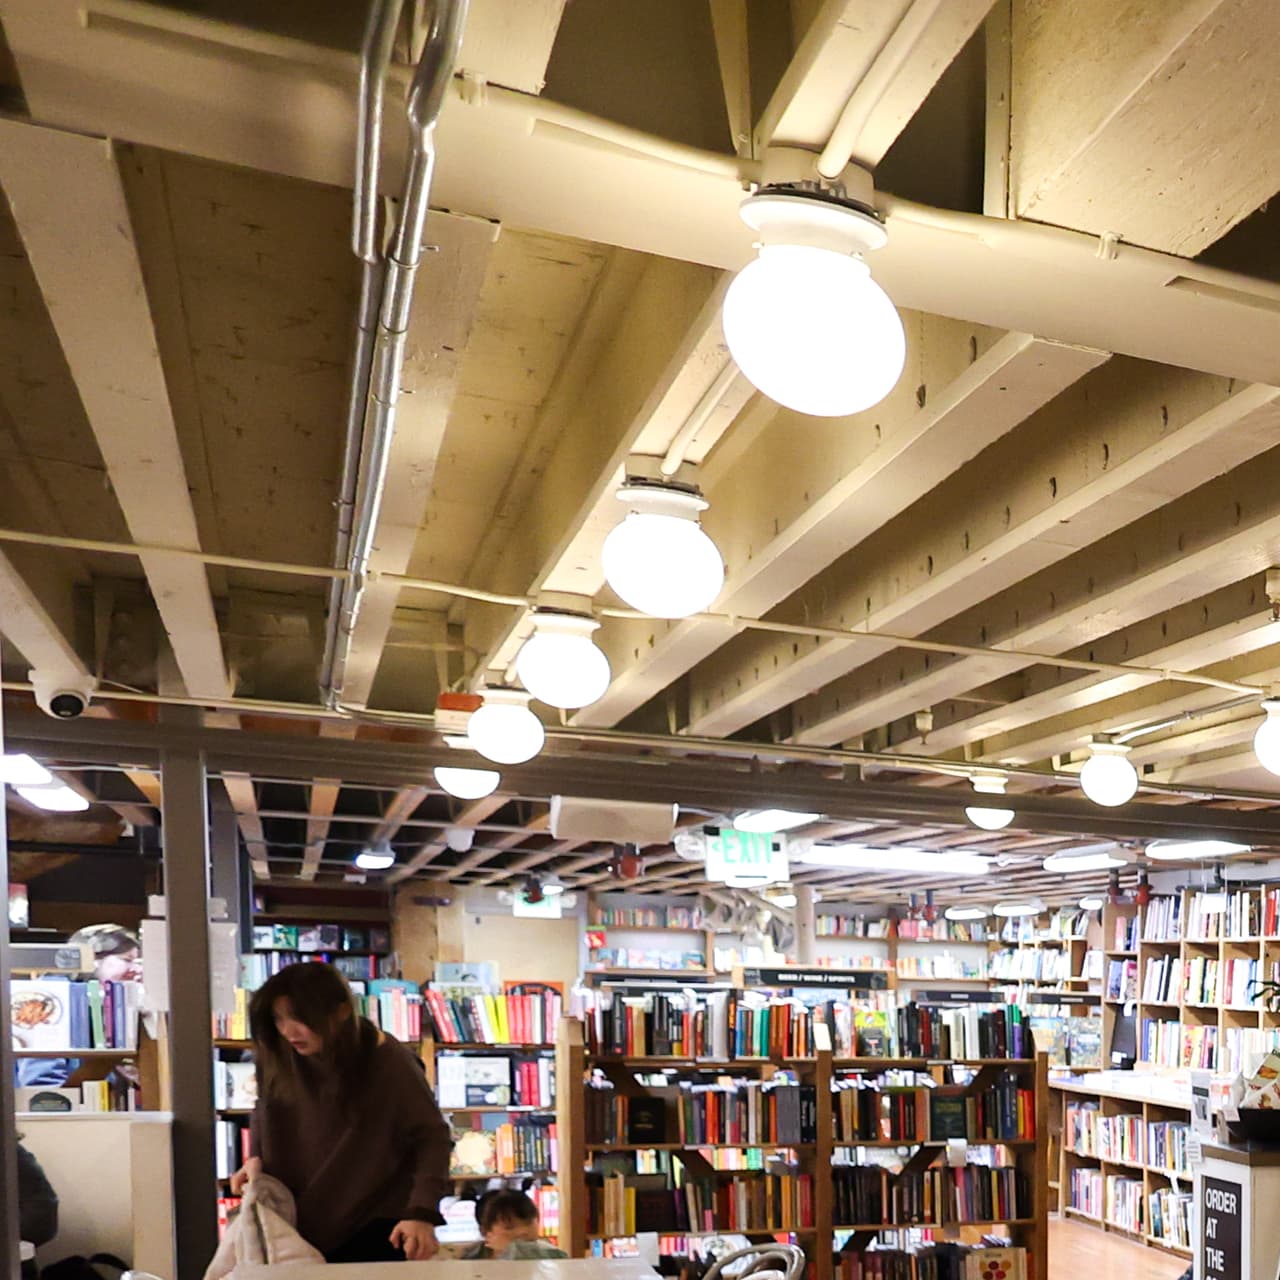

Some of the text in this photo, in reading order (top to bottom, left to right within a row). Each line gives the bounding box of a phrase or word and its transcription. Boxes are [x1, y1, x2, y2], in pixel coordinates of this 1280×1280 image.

[720, 829, 774, 863] EXIT
[1205, 1187, 1237, 1216] ORDER
[1206, 1216, 1218, 1239] AT
[1206, 1246, 1224, 1272] THE
